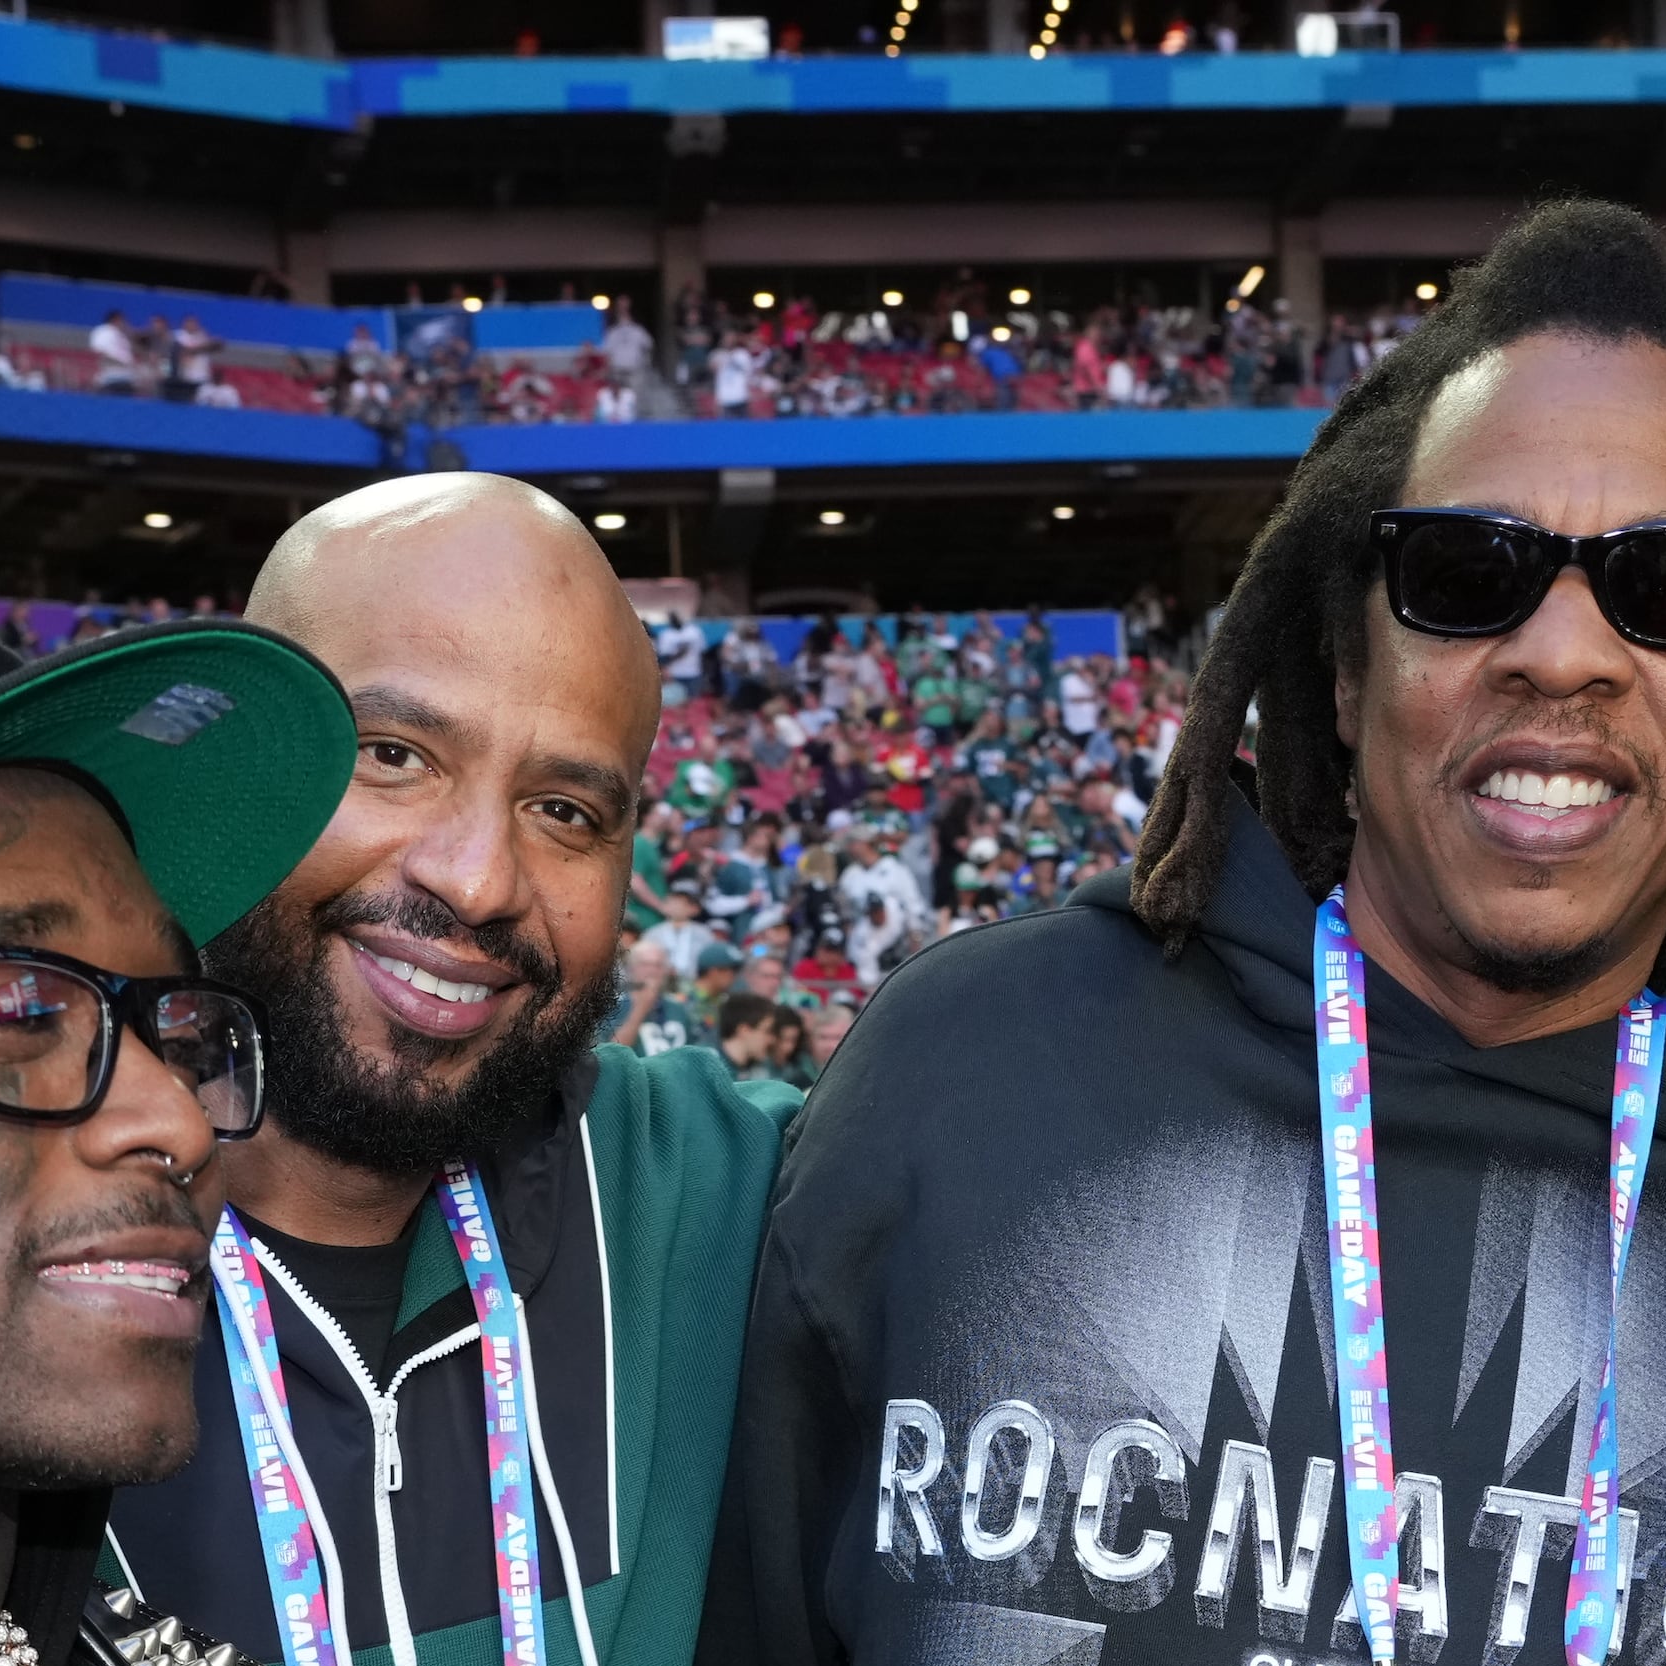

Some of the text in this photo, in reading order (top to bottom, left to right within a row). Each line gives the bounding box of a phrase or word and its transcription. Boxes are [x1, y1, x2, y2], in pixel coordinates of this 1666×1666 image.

[1325, 950, 1348, 964] SUPER
[1326, 964, 1348, 979] BOWL
[1326, 979, 1351, 1045] LVII
[1333, 1124, 1368, 1308] GAMEDAY
[492, 1336, 515, 1400] LVII
[256, 1446, 290, 1514] LVII
[1352, 1422, 1378, 1490] LVII
[1589, 1469, 1609, 1537] LVII
